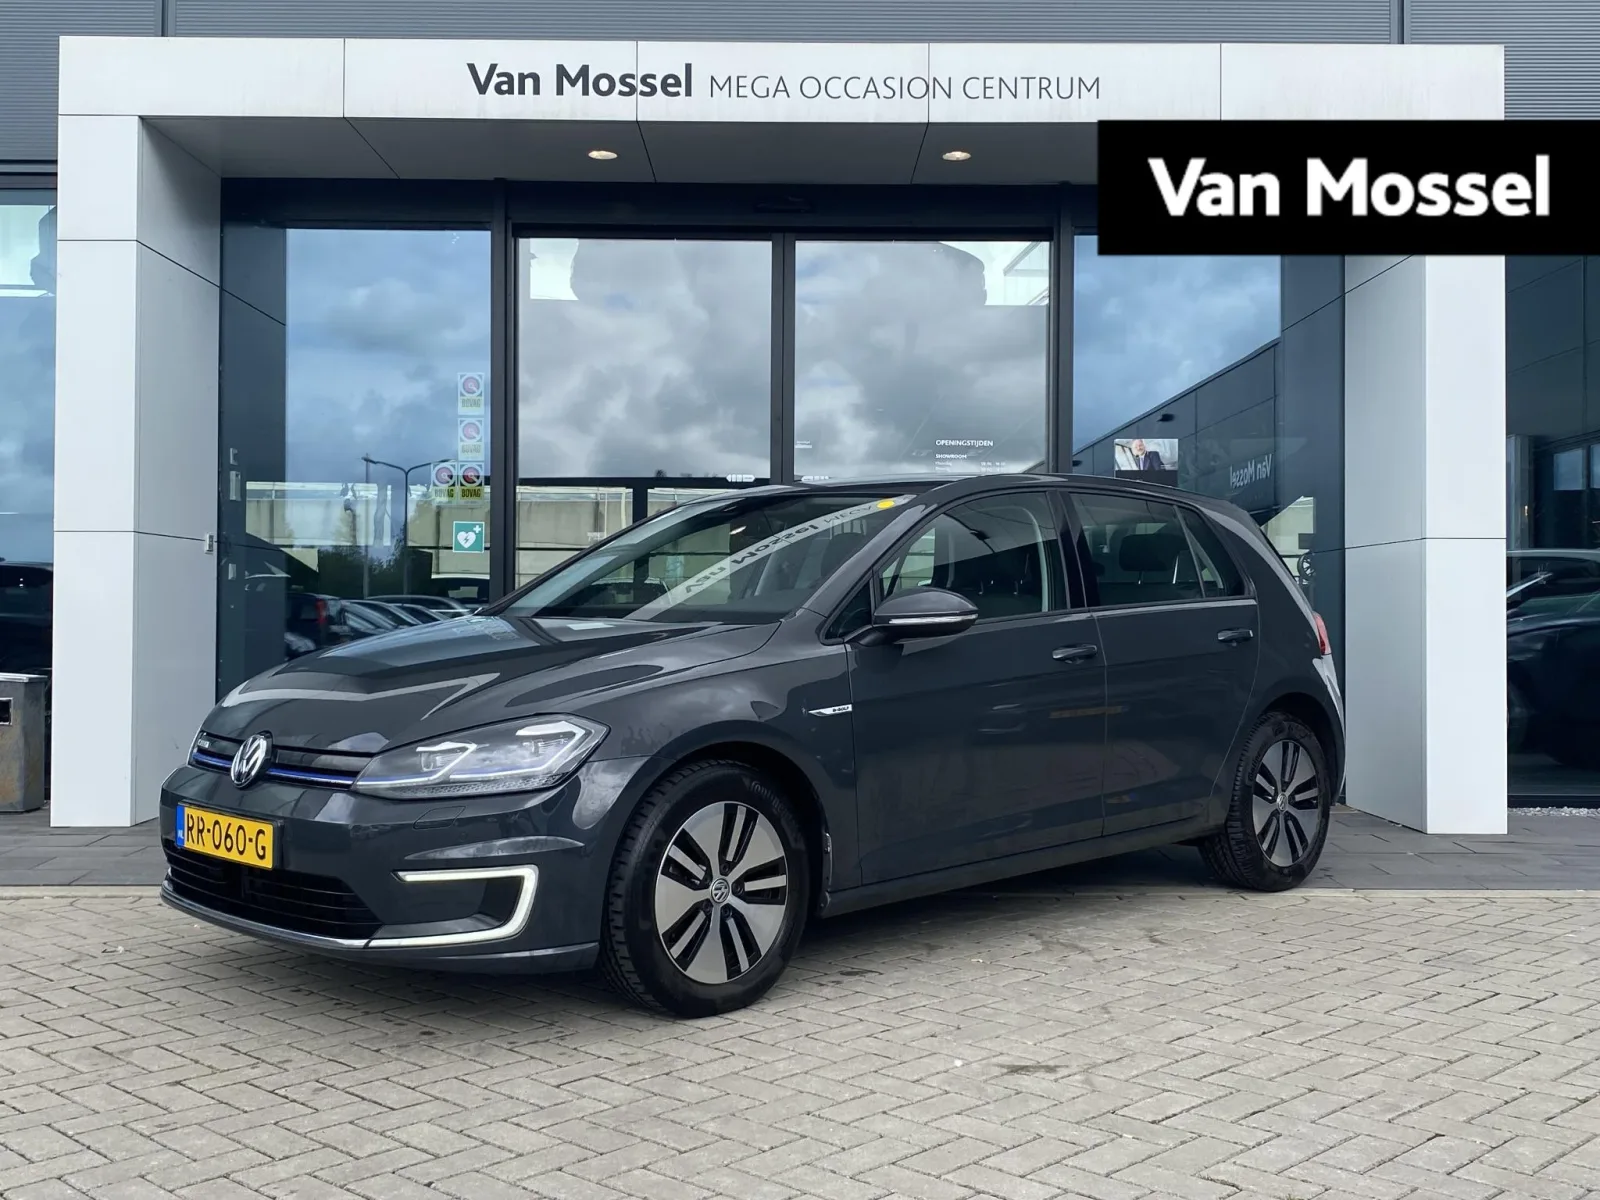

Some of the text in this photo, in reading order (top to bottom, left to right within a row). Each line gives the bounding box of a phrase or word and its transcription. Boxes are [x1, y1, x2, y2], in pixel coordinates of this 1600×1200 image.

[467, 62, 1101, 100] Van Mossel MEGA OCCASION CENTRUM
[935, 439, 994, 448] OPENINGSTIJDEN
[461, 488, 481, 498] BOVAG
[187, 813, 266, 860] RR-060-G
